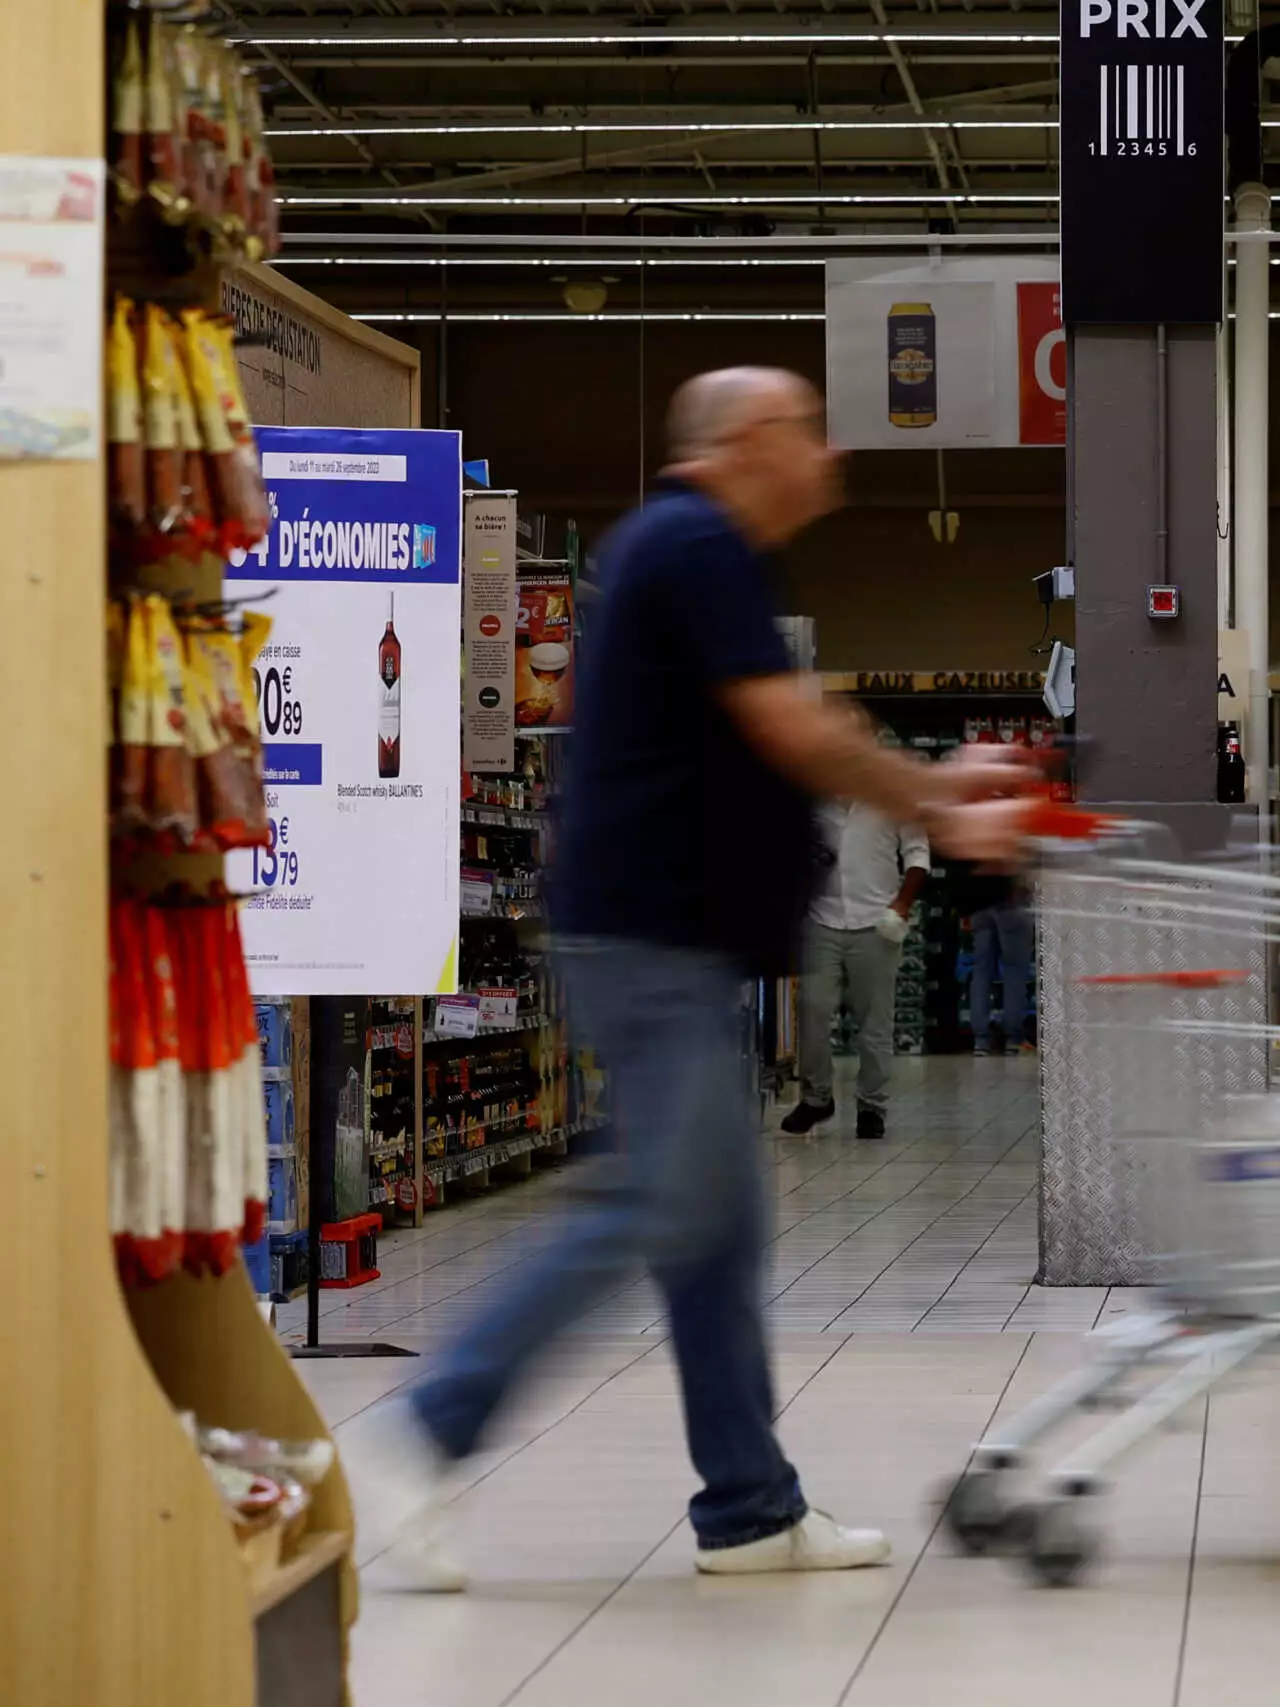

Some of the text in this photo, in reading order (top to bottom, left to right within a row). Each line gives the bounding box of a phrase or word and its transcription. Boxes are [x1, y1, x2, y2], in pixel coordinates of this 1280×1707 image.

[1079, 0, 1208, 38] PRIX
[1088, 143, 1095, 155] 1
[1187, 143, 1197, 155] 6
[279, 508, 410, 570] D'ÉCONOMIES
[857, 672, 1043, 690] EAUX GAZEUSES
